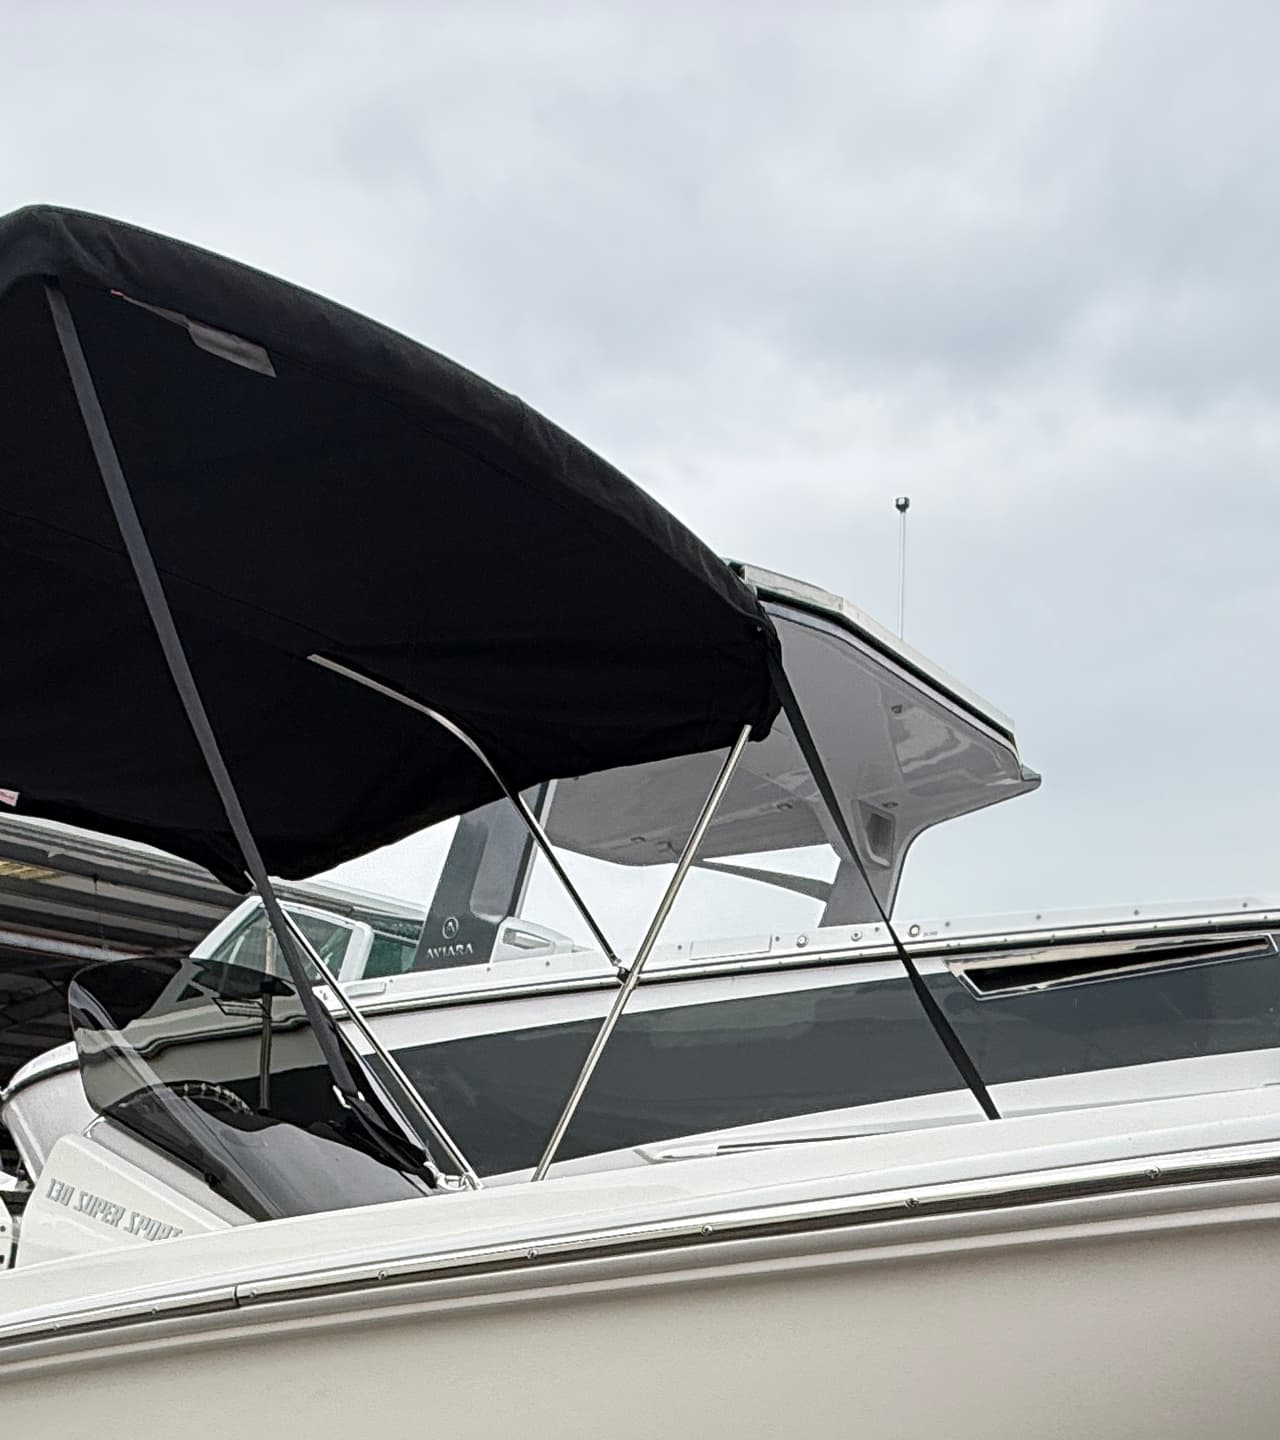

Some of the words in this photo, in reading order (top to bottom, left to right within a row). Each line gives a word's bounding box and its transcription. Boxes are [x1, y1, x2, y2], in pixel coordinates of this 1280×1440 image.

[426, 942, 474, 960] AVIARA
[45, 1178, 75, 1207] 130
[73, 1190, 126, 1228] SUPER
